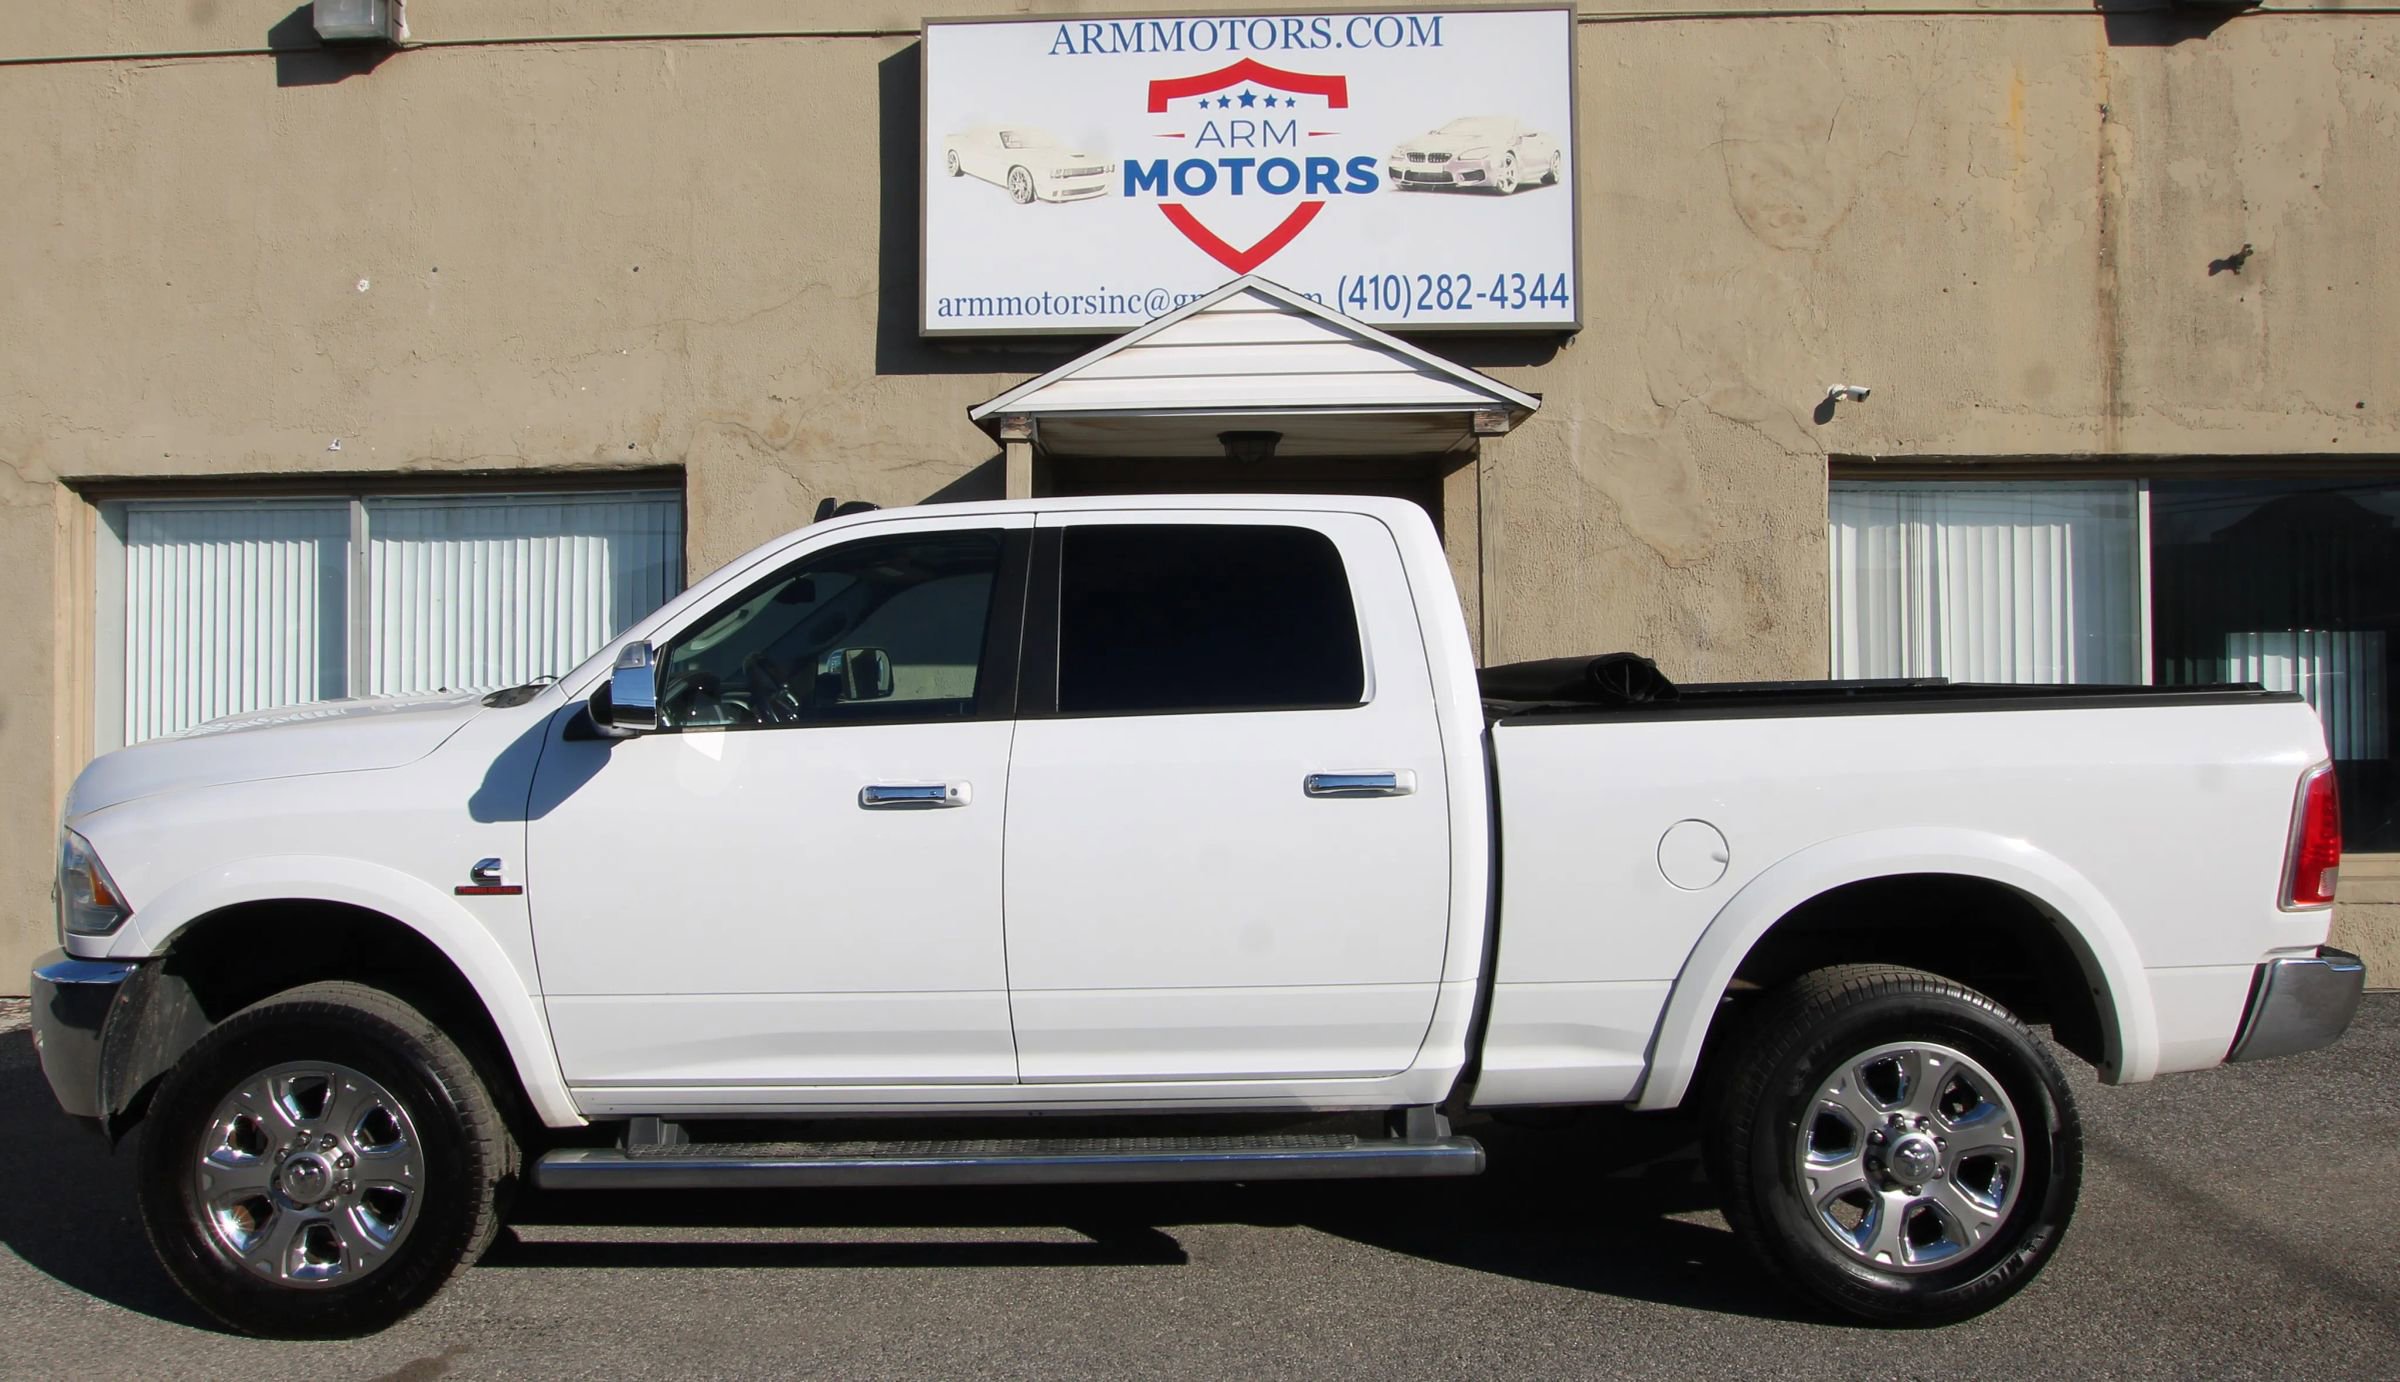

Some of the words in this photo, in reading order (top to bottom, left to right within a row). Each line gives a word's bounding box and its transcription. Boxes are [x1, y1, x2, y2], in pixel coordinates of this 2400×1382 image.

[1048, 15, 1443, 56] ARMMOTORS.COM
[1194, 118, 1297, 149] ARM
[1122, 155, 1381, 198] MOTORS
[1336, 272, 1569, 318] (410)282-4344
